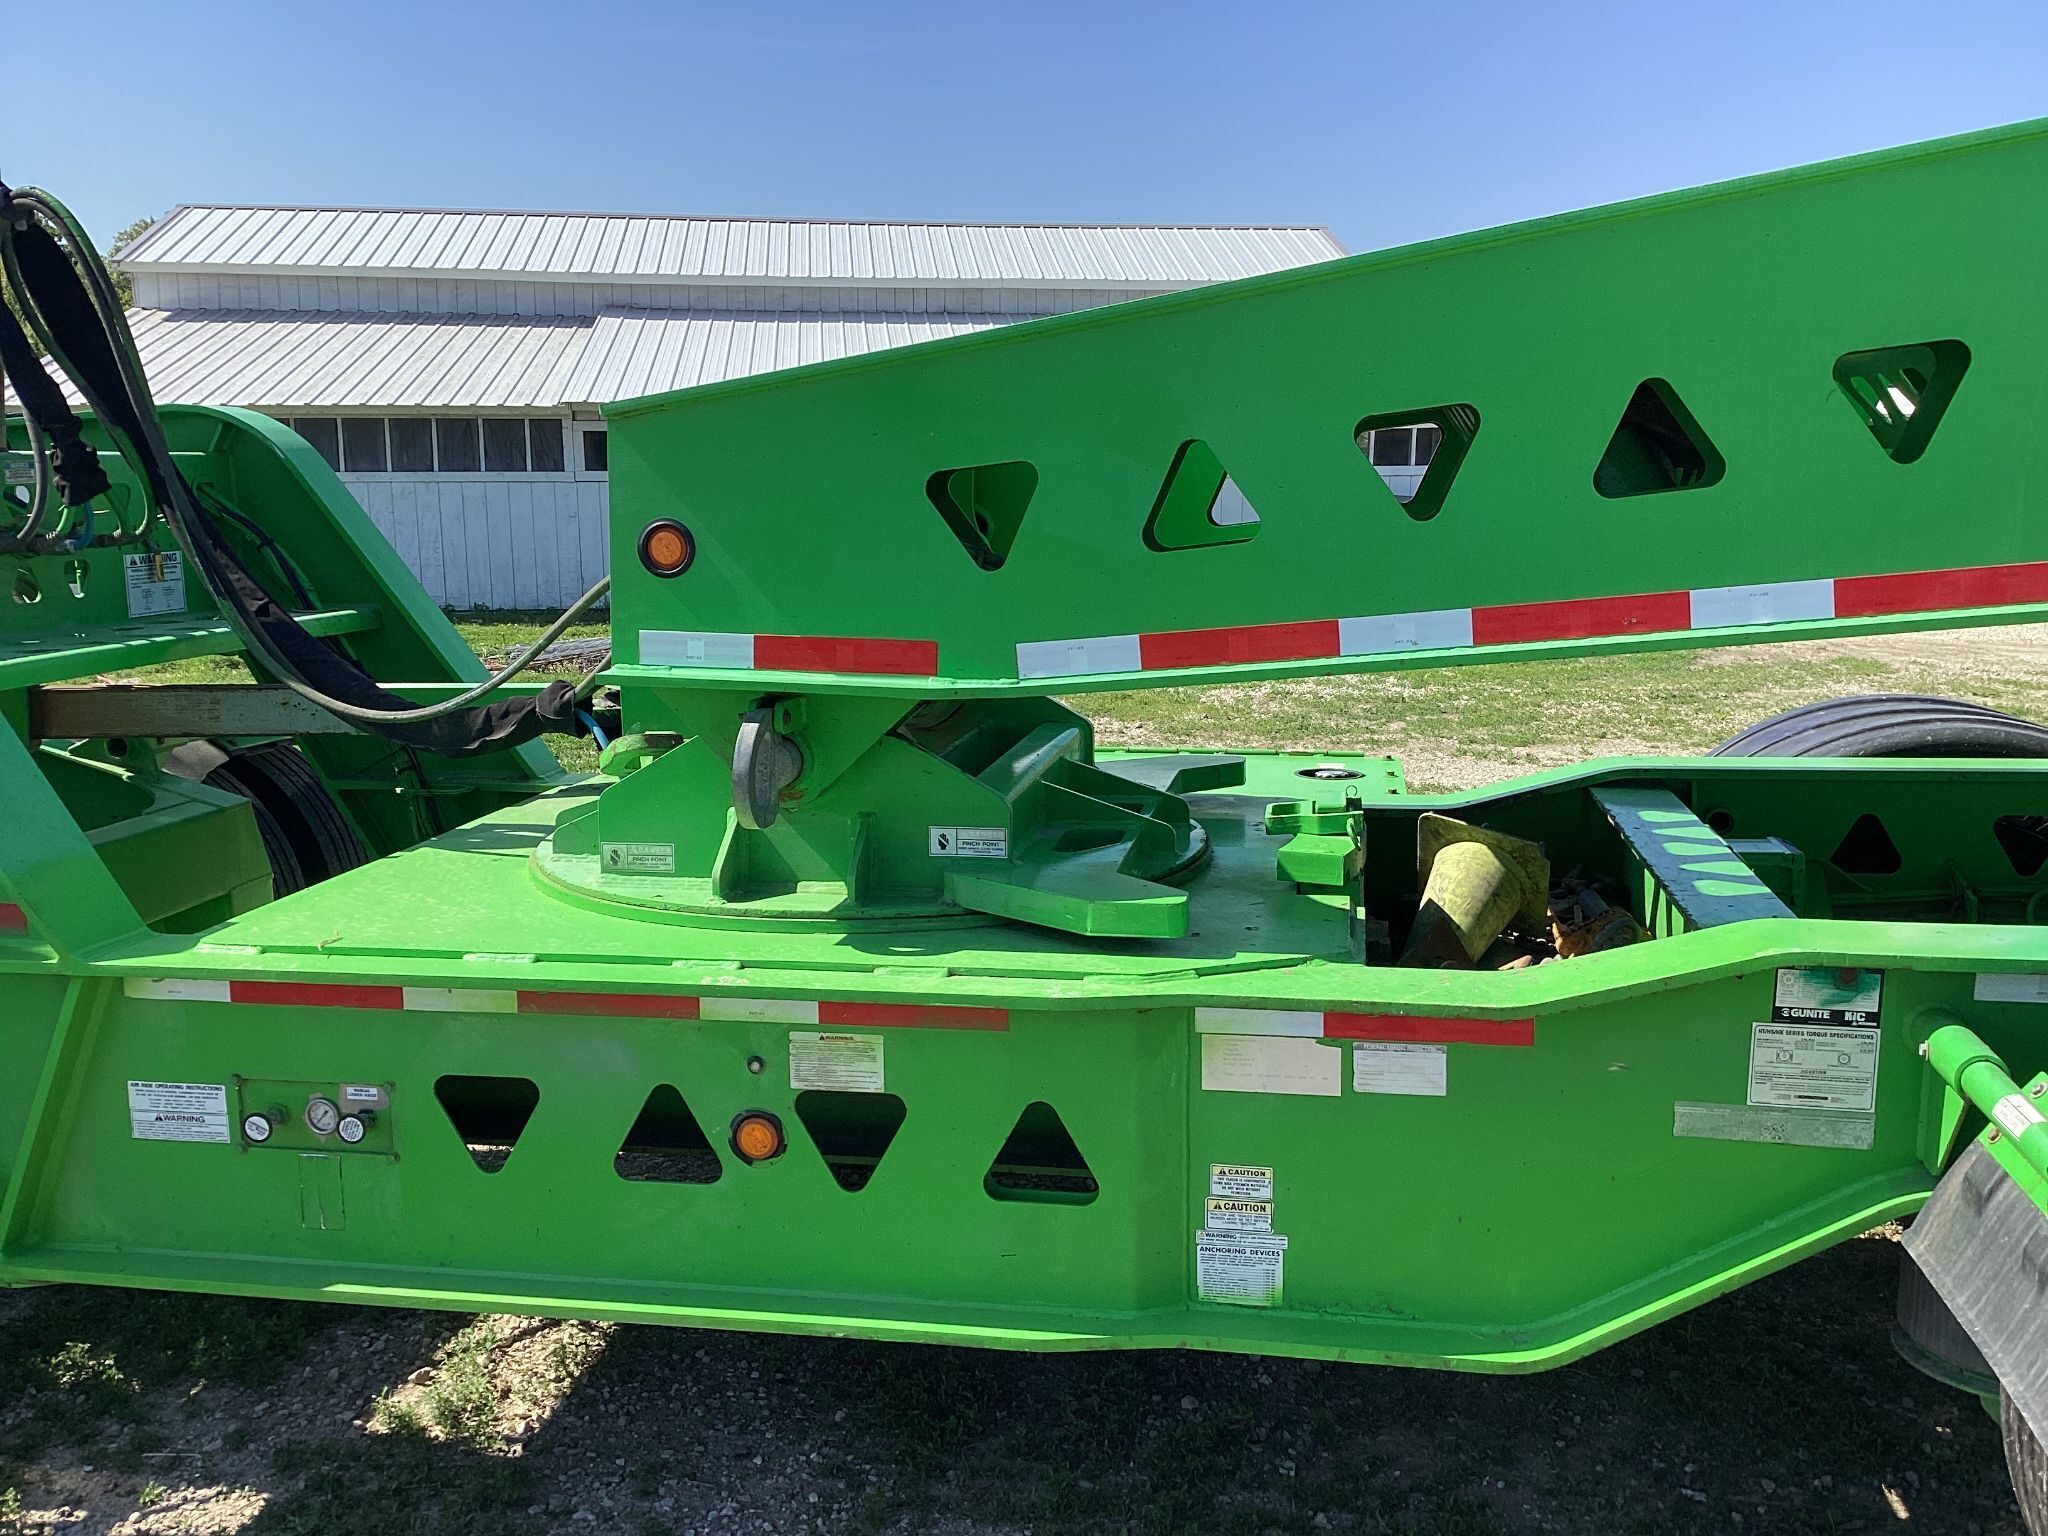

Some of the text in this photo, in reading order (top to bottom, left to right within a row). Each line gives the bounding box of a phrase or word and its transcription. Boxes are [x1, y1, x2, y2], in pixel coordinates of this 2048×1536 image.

[138, 553, 178, 565] WAING
[1790, 1008, 1831, 1019] GUNITE
[1829, 1032, 1874, 1040] SPECIFICATIONS
[163, 1115, 206, 1123] WARNING
[1228, 1169, 1266, 1177] CAUTION
[1223, 1202, 1266, 1212] CAUTION
[1205, 1232, 1237, 1240] WARNING
[1200, 1246, 1280, 1257] ANCHORING DEVICES
